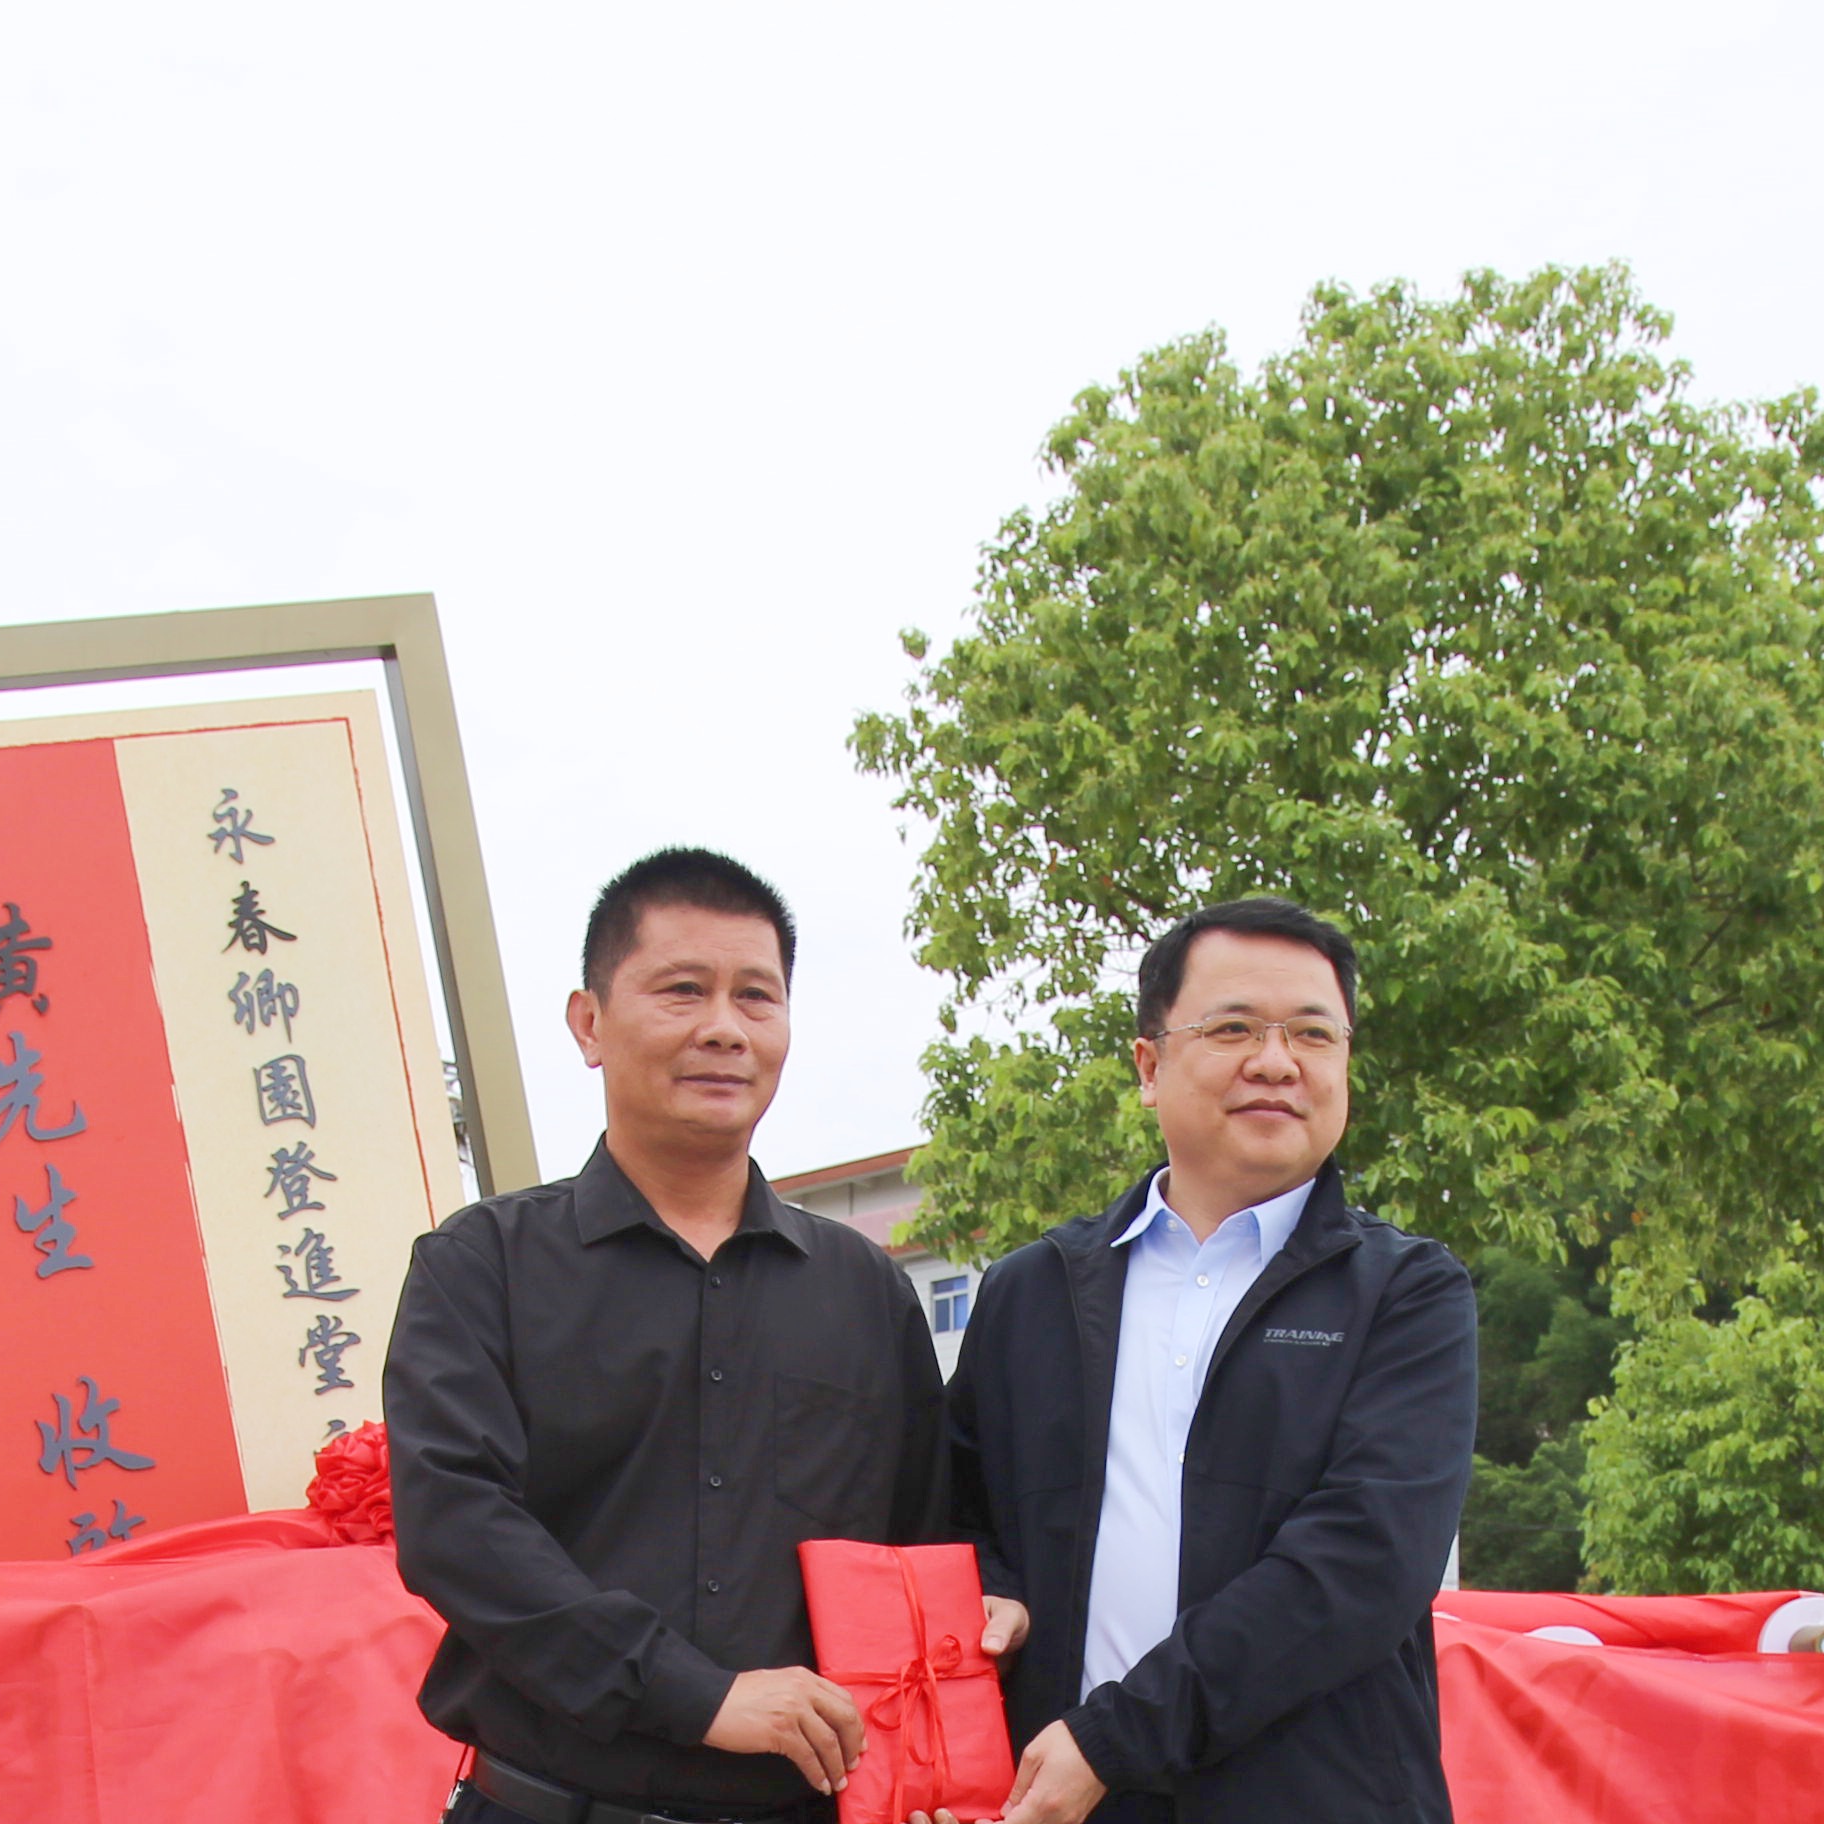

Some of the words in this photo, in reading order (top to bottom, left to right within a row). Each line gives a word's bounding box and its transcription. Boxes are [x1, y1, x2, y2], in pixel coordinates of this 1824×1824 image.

[206, 787, 362, 1455] 永春卿園登進堂
[1264, 1328, 1345, 1343] TRAINING
